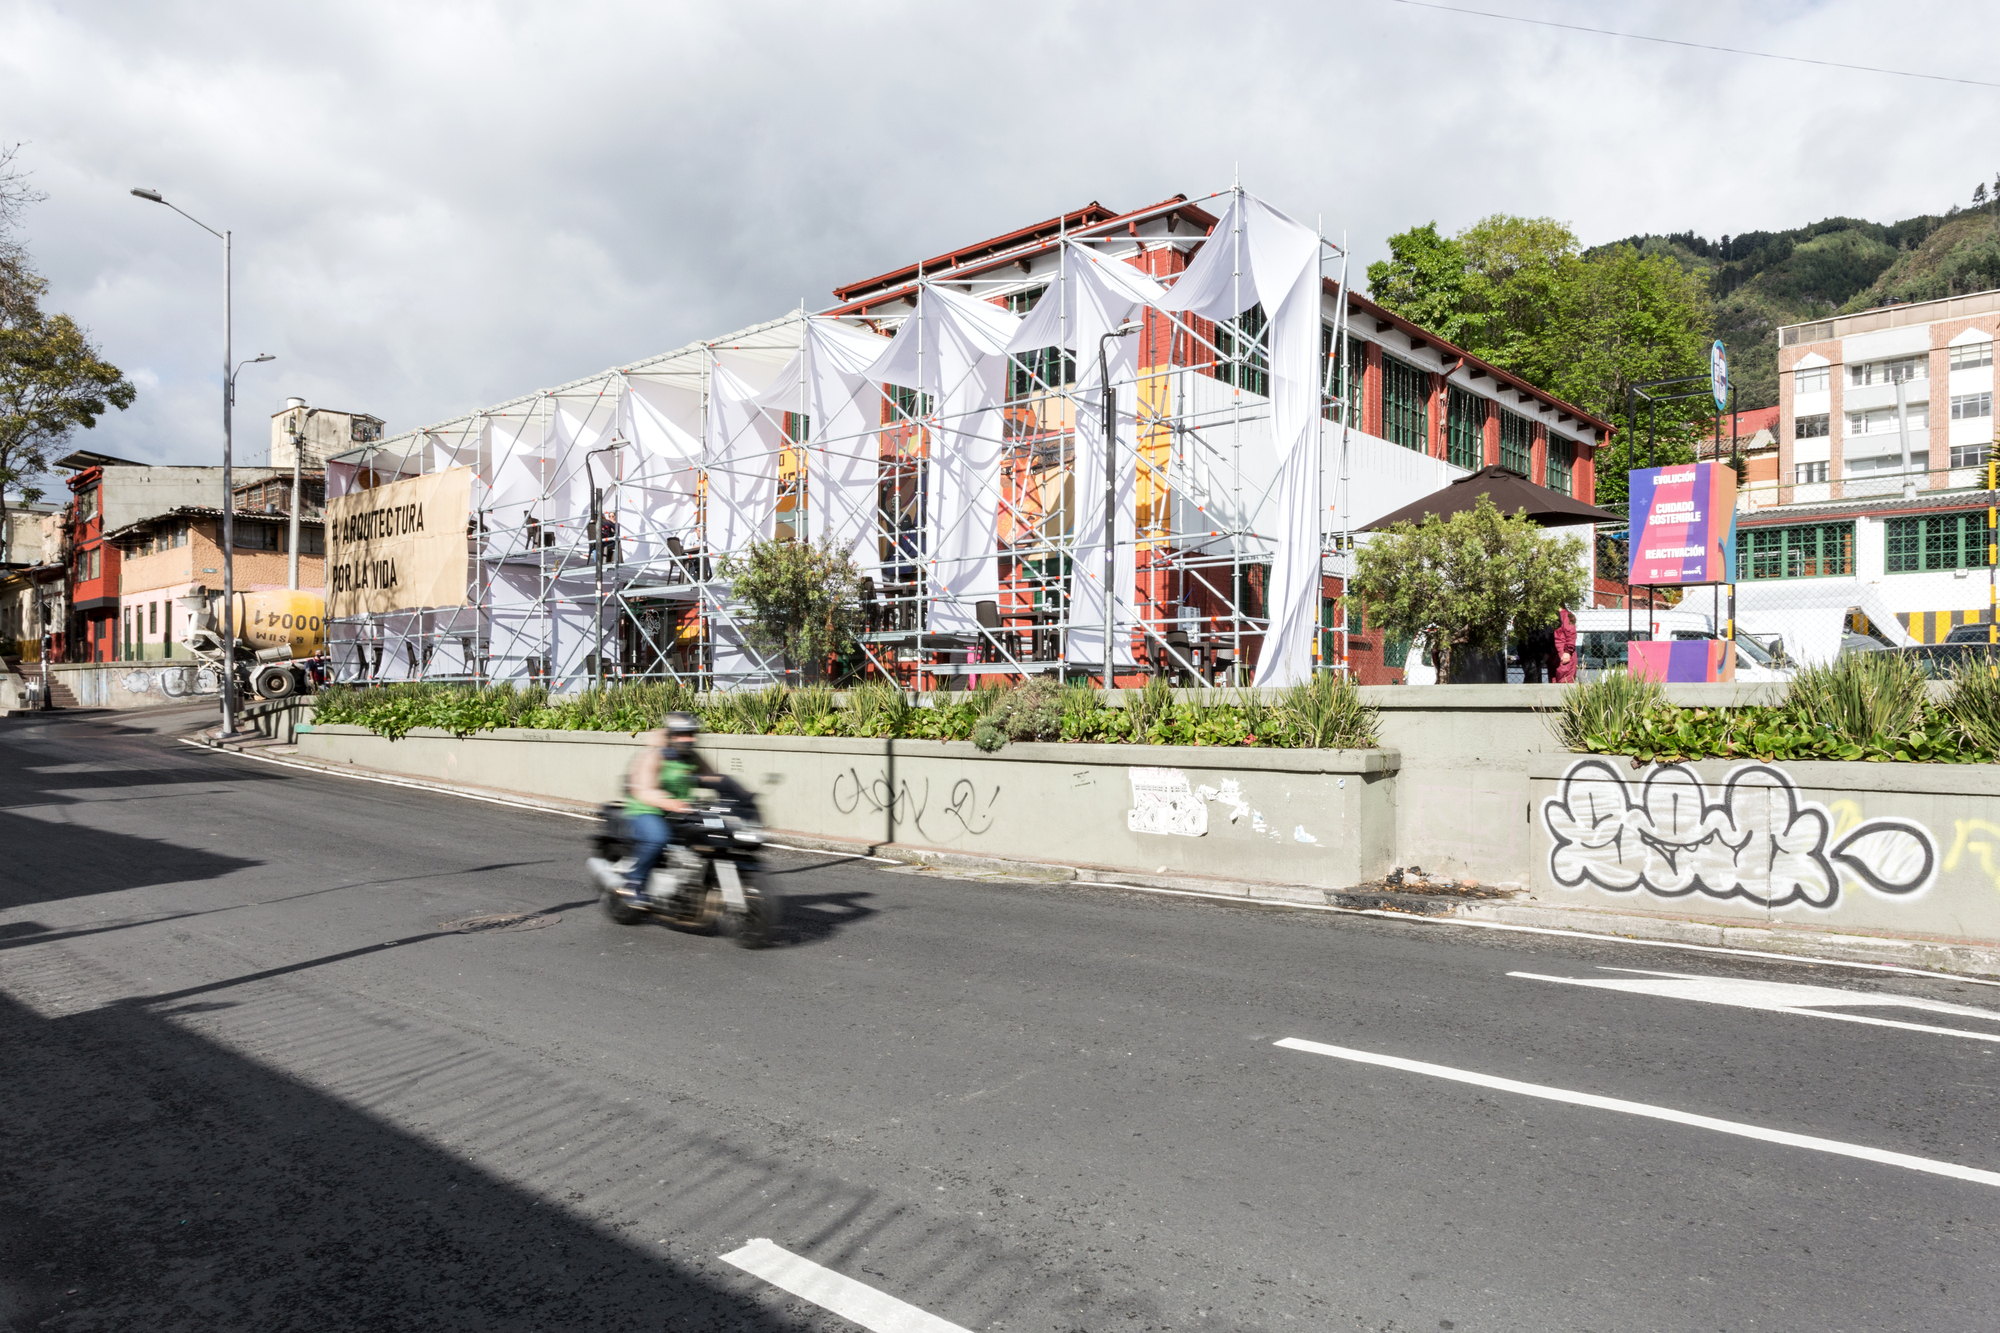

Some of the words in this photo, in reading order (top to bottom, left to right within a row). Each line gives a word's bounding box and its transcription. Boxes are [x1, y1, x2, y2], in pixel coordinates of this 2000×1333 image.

[1653, 471, 1696, 485] EVOLUCIÓN
[1656, 501, 1694, 514] CUIDADO
[342, 502, 425, 545] ARQUITECTURA
[1649, 511, 1701, 525] SOSTENIBLE
[1645, 544, 1705, 560] REACTIVACIÓN
[332, 564, 352, 593] POR
[355, 560, 369, 589] LA
[372, 557, 398, 589] VIDA
